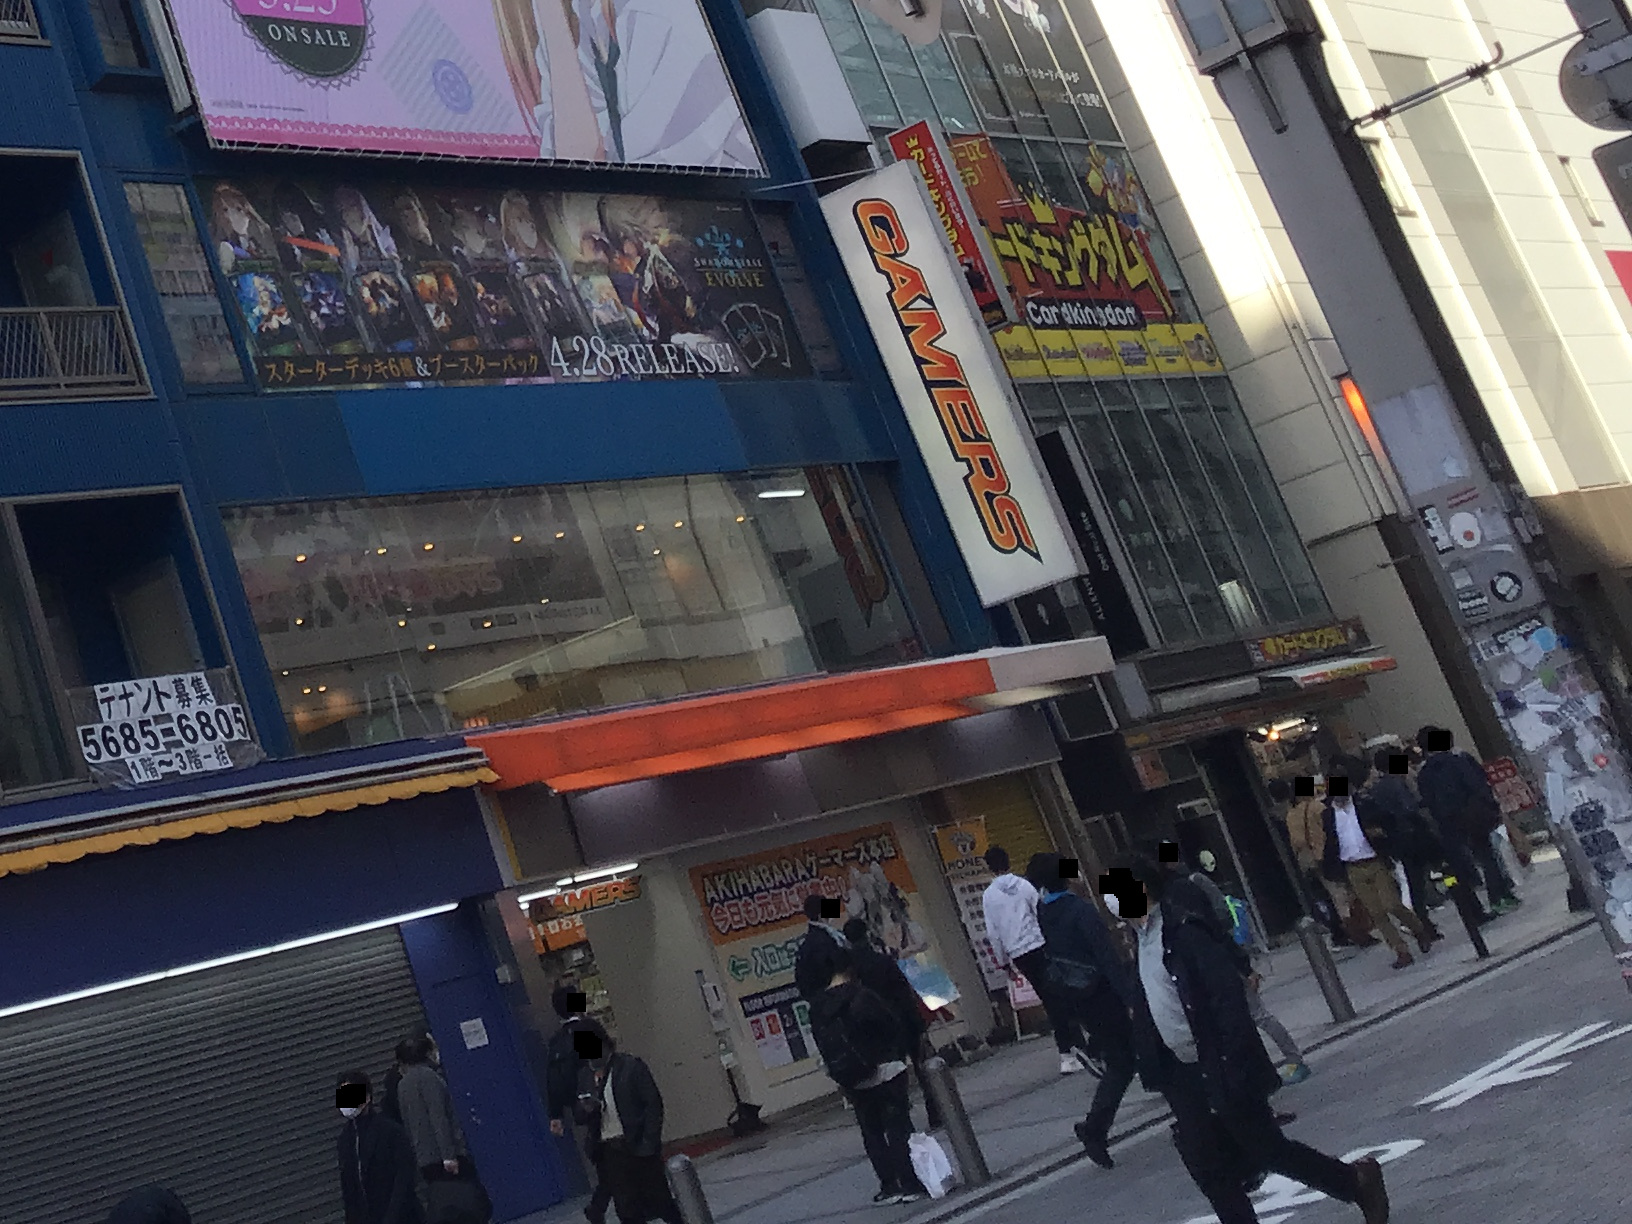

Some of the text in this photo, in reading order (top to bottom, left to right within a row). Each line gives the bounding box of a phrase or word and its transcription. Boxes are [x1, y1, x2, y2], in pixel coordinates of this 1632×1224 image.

[268, 23, 351, 48] ON SALE
[980, 214, 1150, 290] ードキングダム
[706, 272, 765, 288] EVOLVE
[550, 335, 740, 377] 4.28 RELEASE!
[852, 196, 1045, 566] GAMERS
[99, 677, 214, 720] テナント募集
